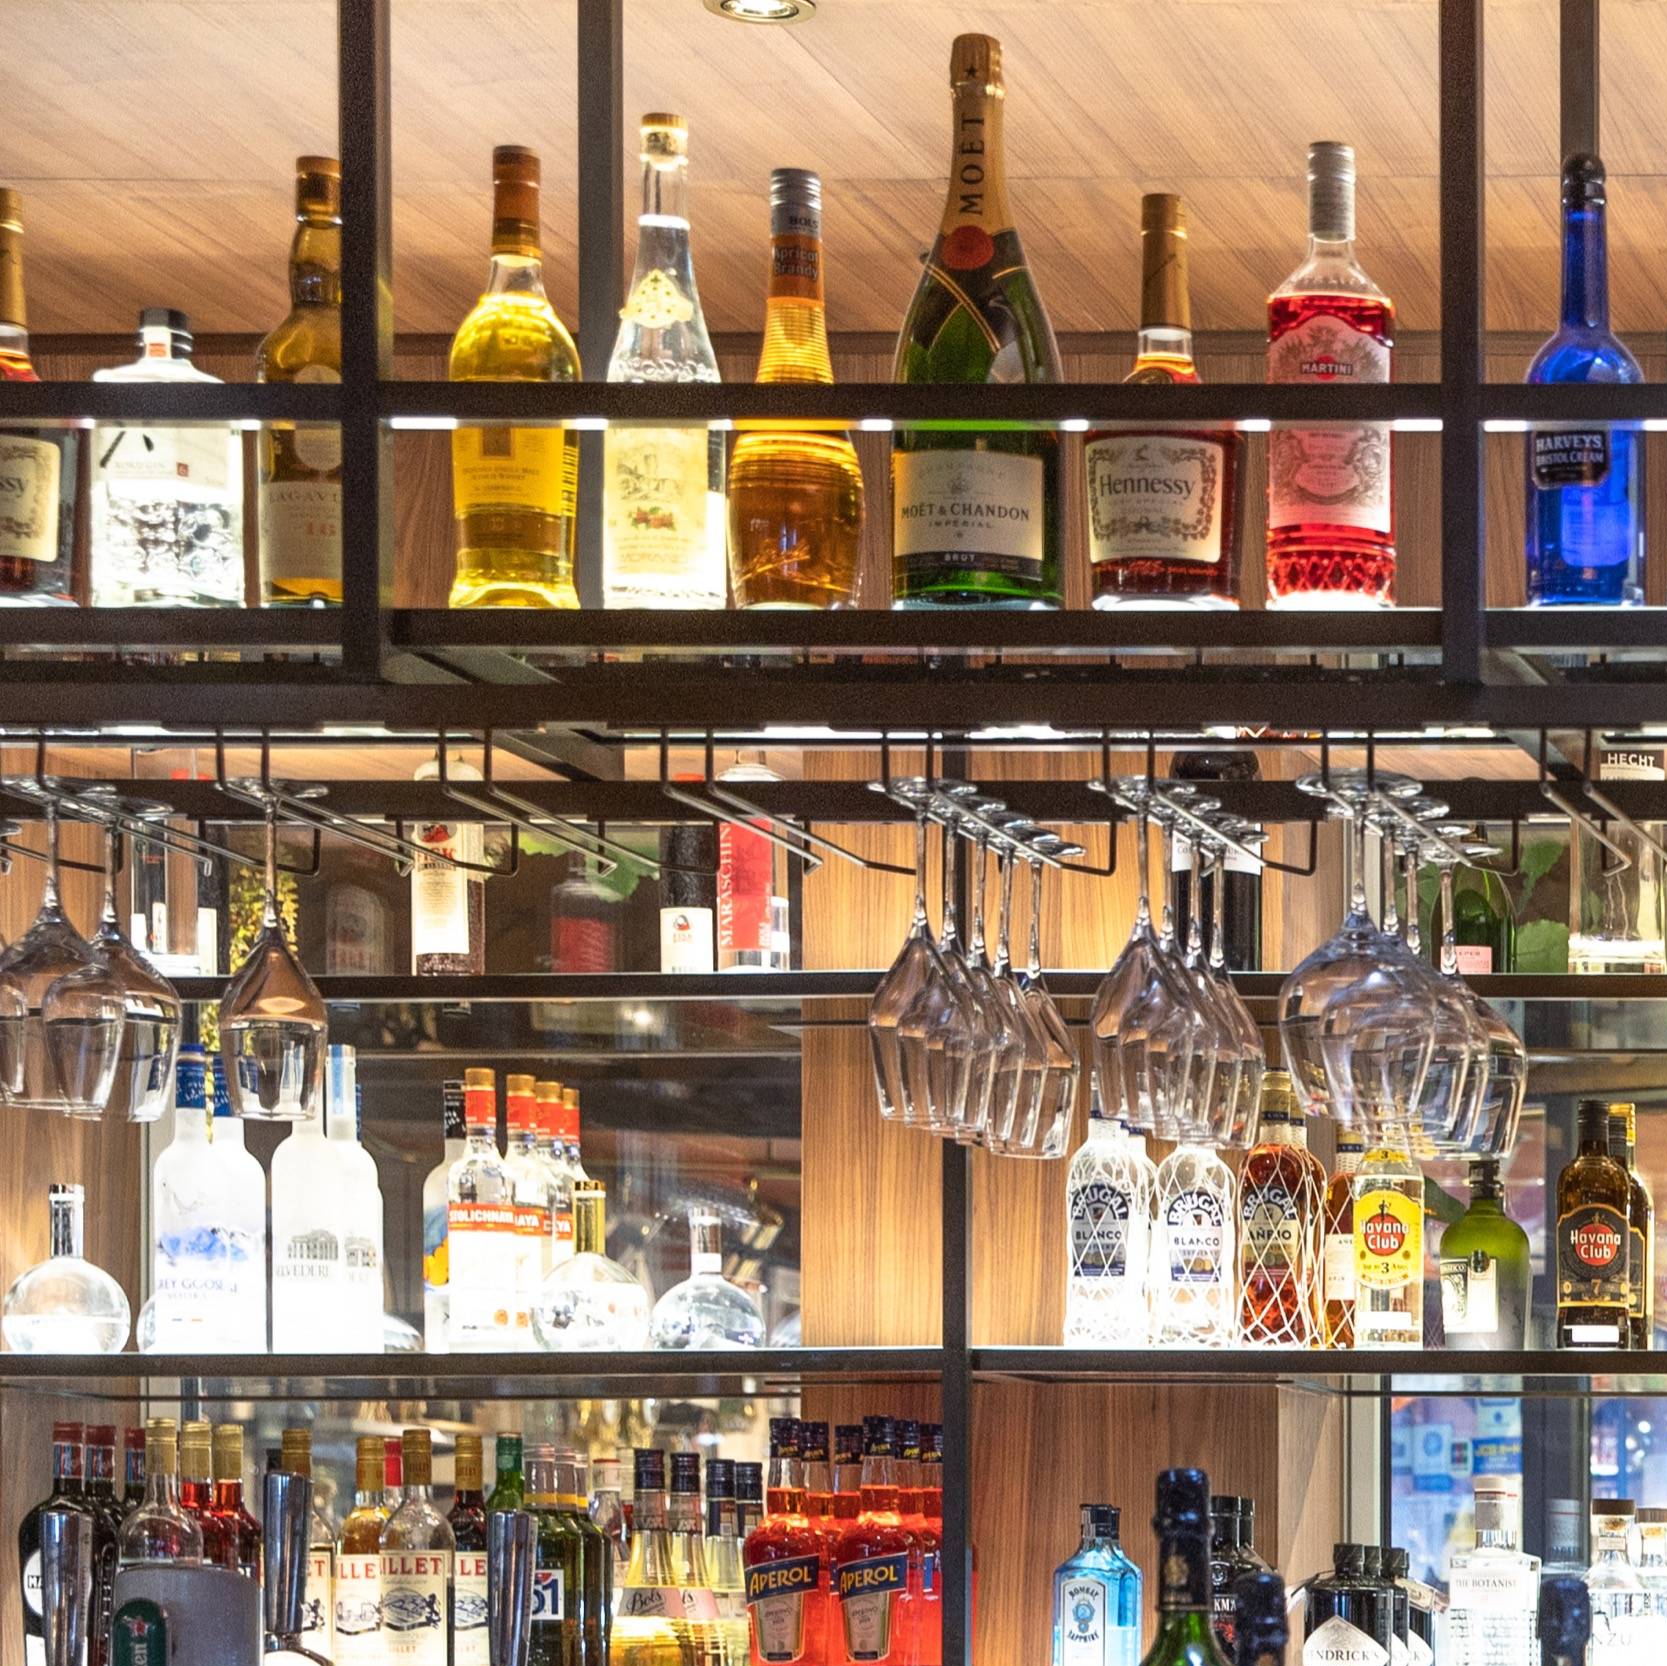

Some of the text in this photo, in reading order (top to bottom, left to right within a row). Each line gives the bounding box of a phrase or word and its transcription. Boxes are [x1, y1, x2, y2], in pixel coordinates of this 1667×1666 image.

[1302, 361, 1352, 376] MARTINI
[1536, 435, 1604, 451] HARVEYS
[1570, 450, 1604, 464] CREAM
[1100, 473, 1197, 499] Hennessy
[949, 500, 1031, 521] CHANDON
[944, 553, 976, 563] BRUT
[719, 822, 734, 947] MARASCHIN
[1071, 1186, 1129, 1220] BRUGAL
[1167, 1191, 1223, 1227] BRUGAL
[1242, 1187, 1298, 1220] BRUGAL
[448, 1208, 514, 1225] STOLICHNA
[1074, 1230, 1123, 1242] BLANCO
[1358, 1220, 1411, 1237] Havana
[1172, 1236, 1221, 1247] BLANCO
[1367, 1233, 1399, 1251] Club
[1569, 1228, 1623, 1248] Havana
[1580, 1242, 1612, 1261] Club
[157, 1279, 182, 1292] REY
[381, 1557, 441, 1578] ILLET
[749, 1566, 813, 1597] APEROL
[840, 1564, 899, 1595] APEROL
[1067, 1585, 1100, 1601] BOMBAY
